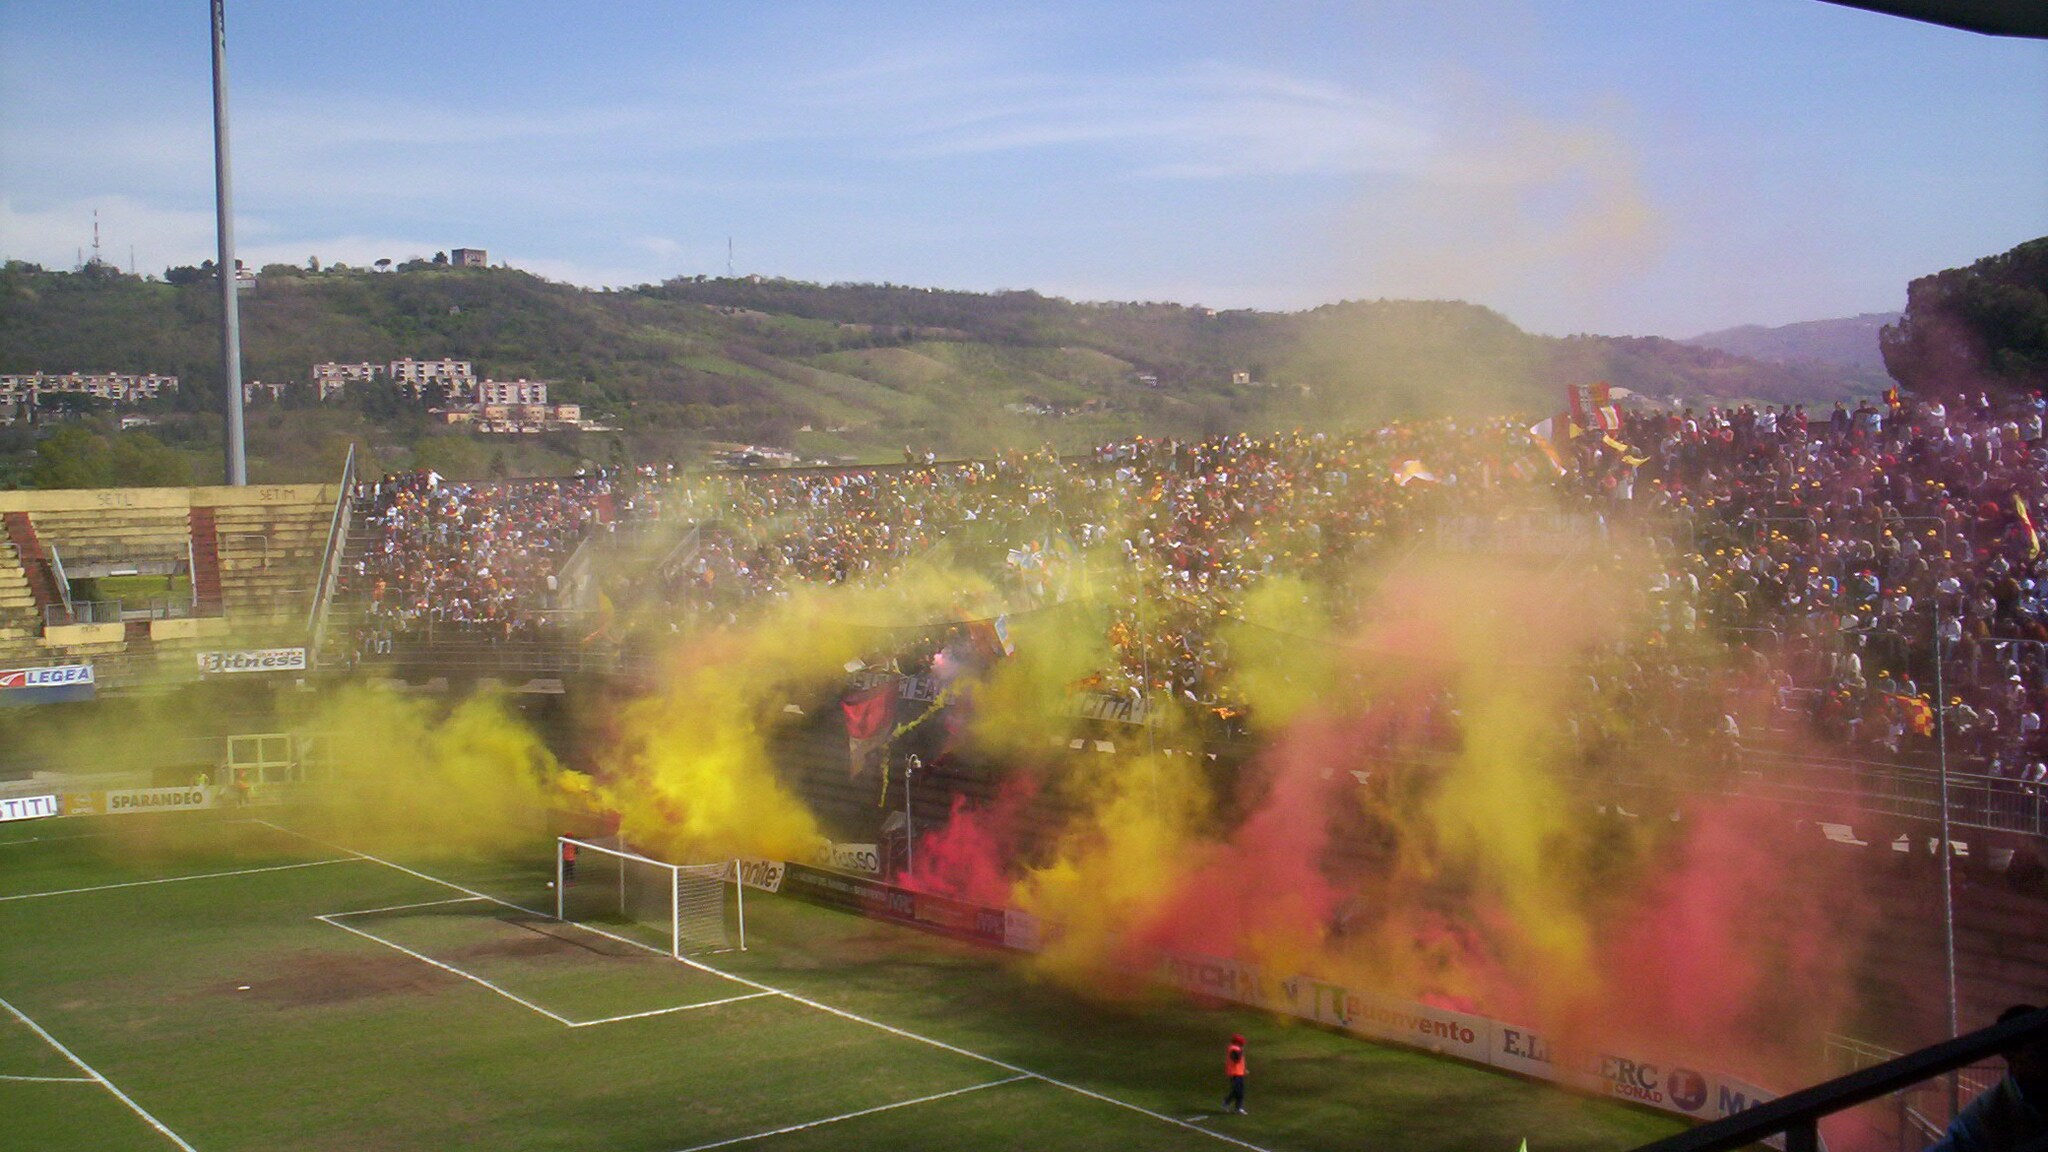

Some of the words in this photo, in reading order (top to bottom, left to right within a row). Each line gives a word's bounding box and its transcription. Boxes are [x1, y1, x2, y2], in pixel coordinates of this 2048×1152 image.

[27, 668, 89, 684] LEGEA
[0, 798, 52, 817] TITI
[111, 791, 203, 809] SPARANDEO
[1615, 1084, 1663, 1103] CONAD
